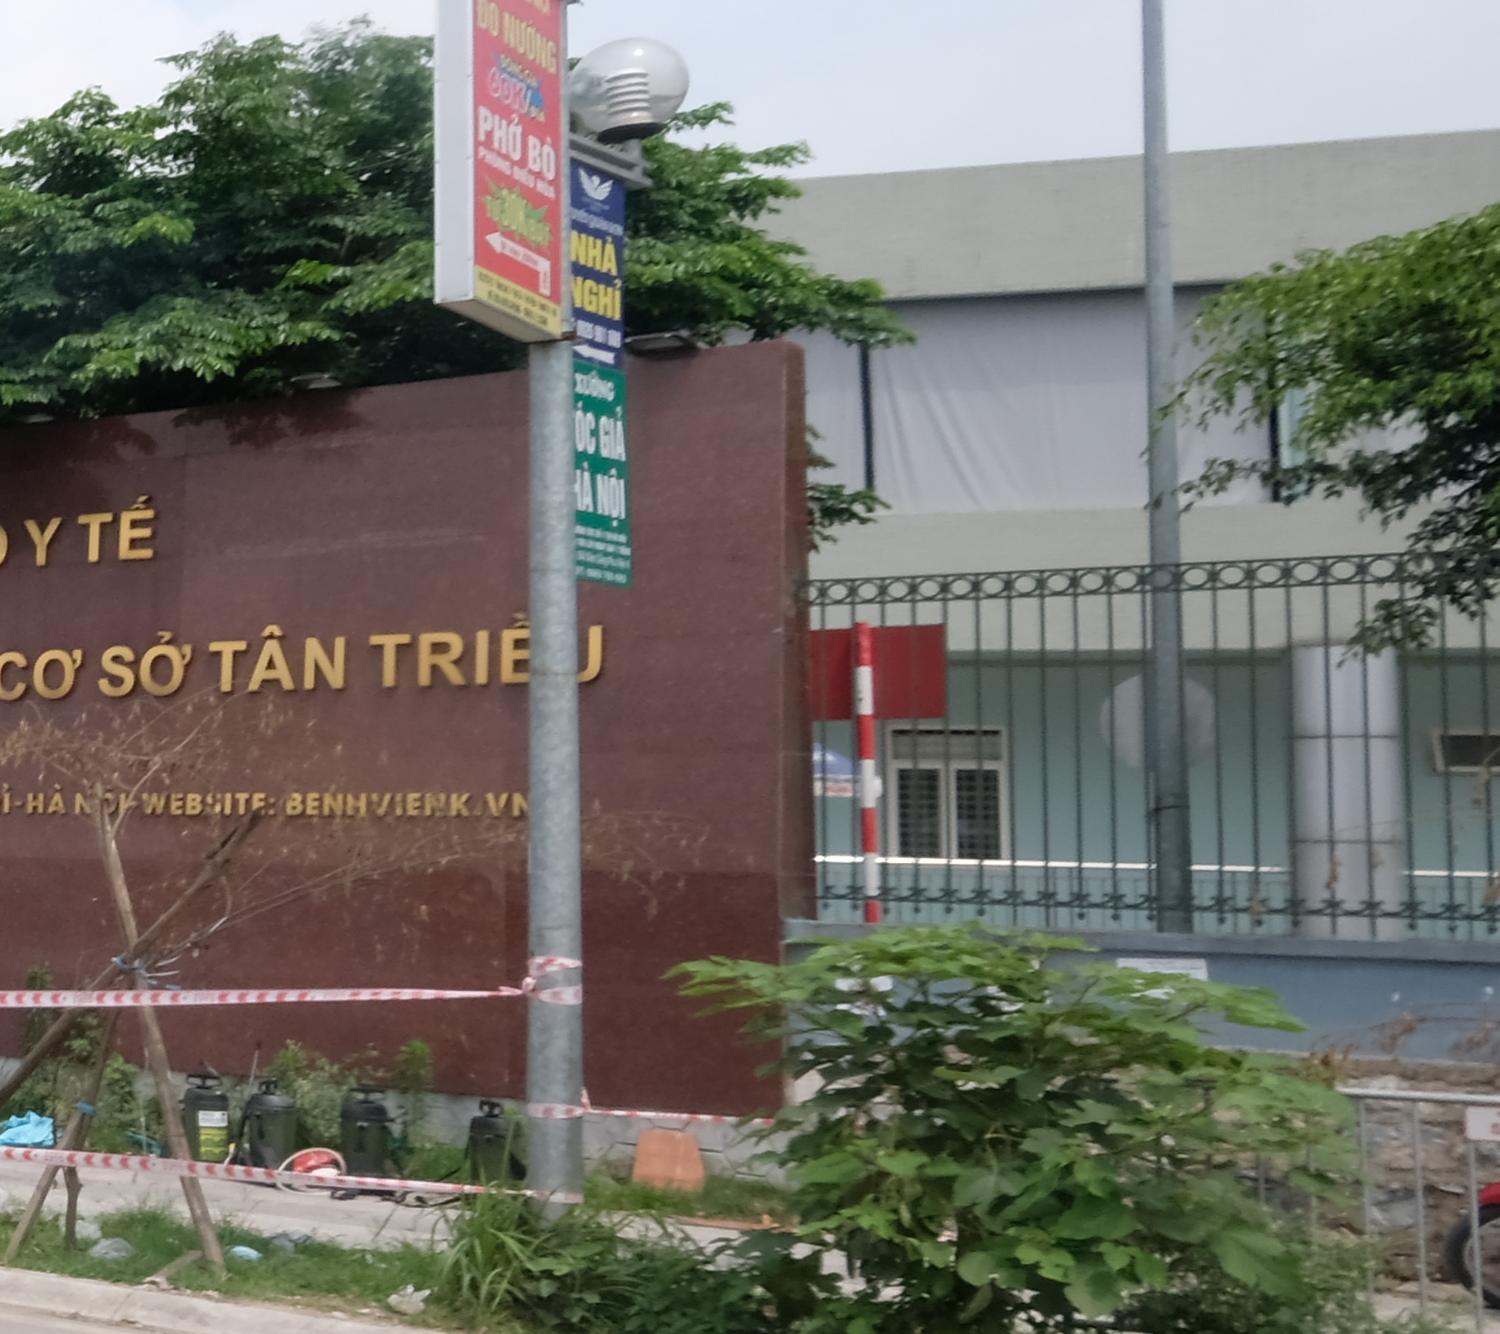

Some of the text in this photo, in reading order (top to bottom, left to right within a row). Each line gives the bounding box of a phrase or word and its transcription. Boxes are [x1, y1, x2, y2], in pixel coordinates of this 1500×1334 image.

[478, 106, 556, 181] PHỞ BÒ
[570, 236, 618, 276] NHÀ
[575, 400, 596, 454] ÓC
[596, 468, 626, 527] NỘI
[24, 517, 62, 566] Y
[78, 495, 155, 564] TẾ
[98, 630, 193, 697] SỞ
[209, 624, 346, 693] TÂN
[27, 783, 66, 814] HÀ
